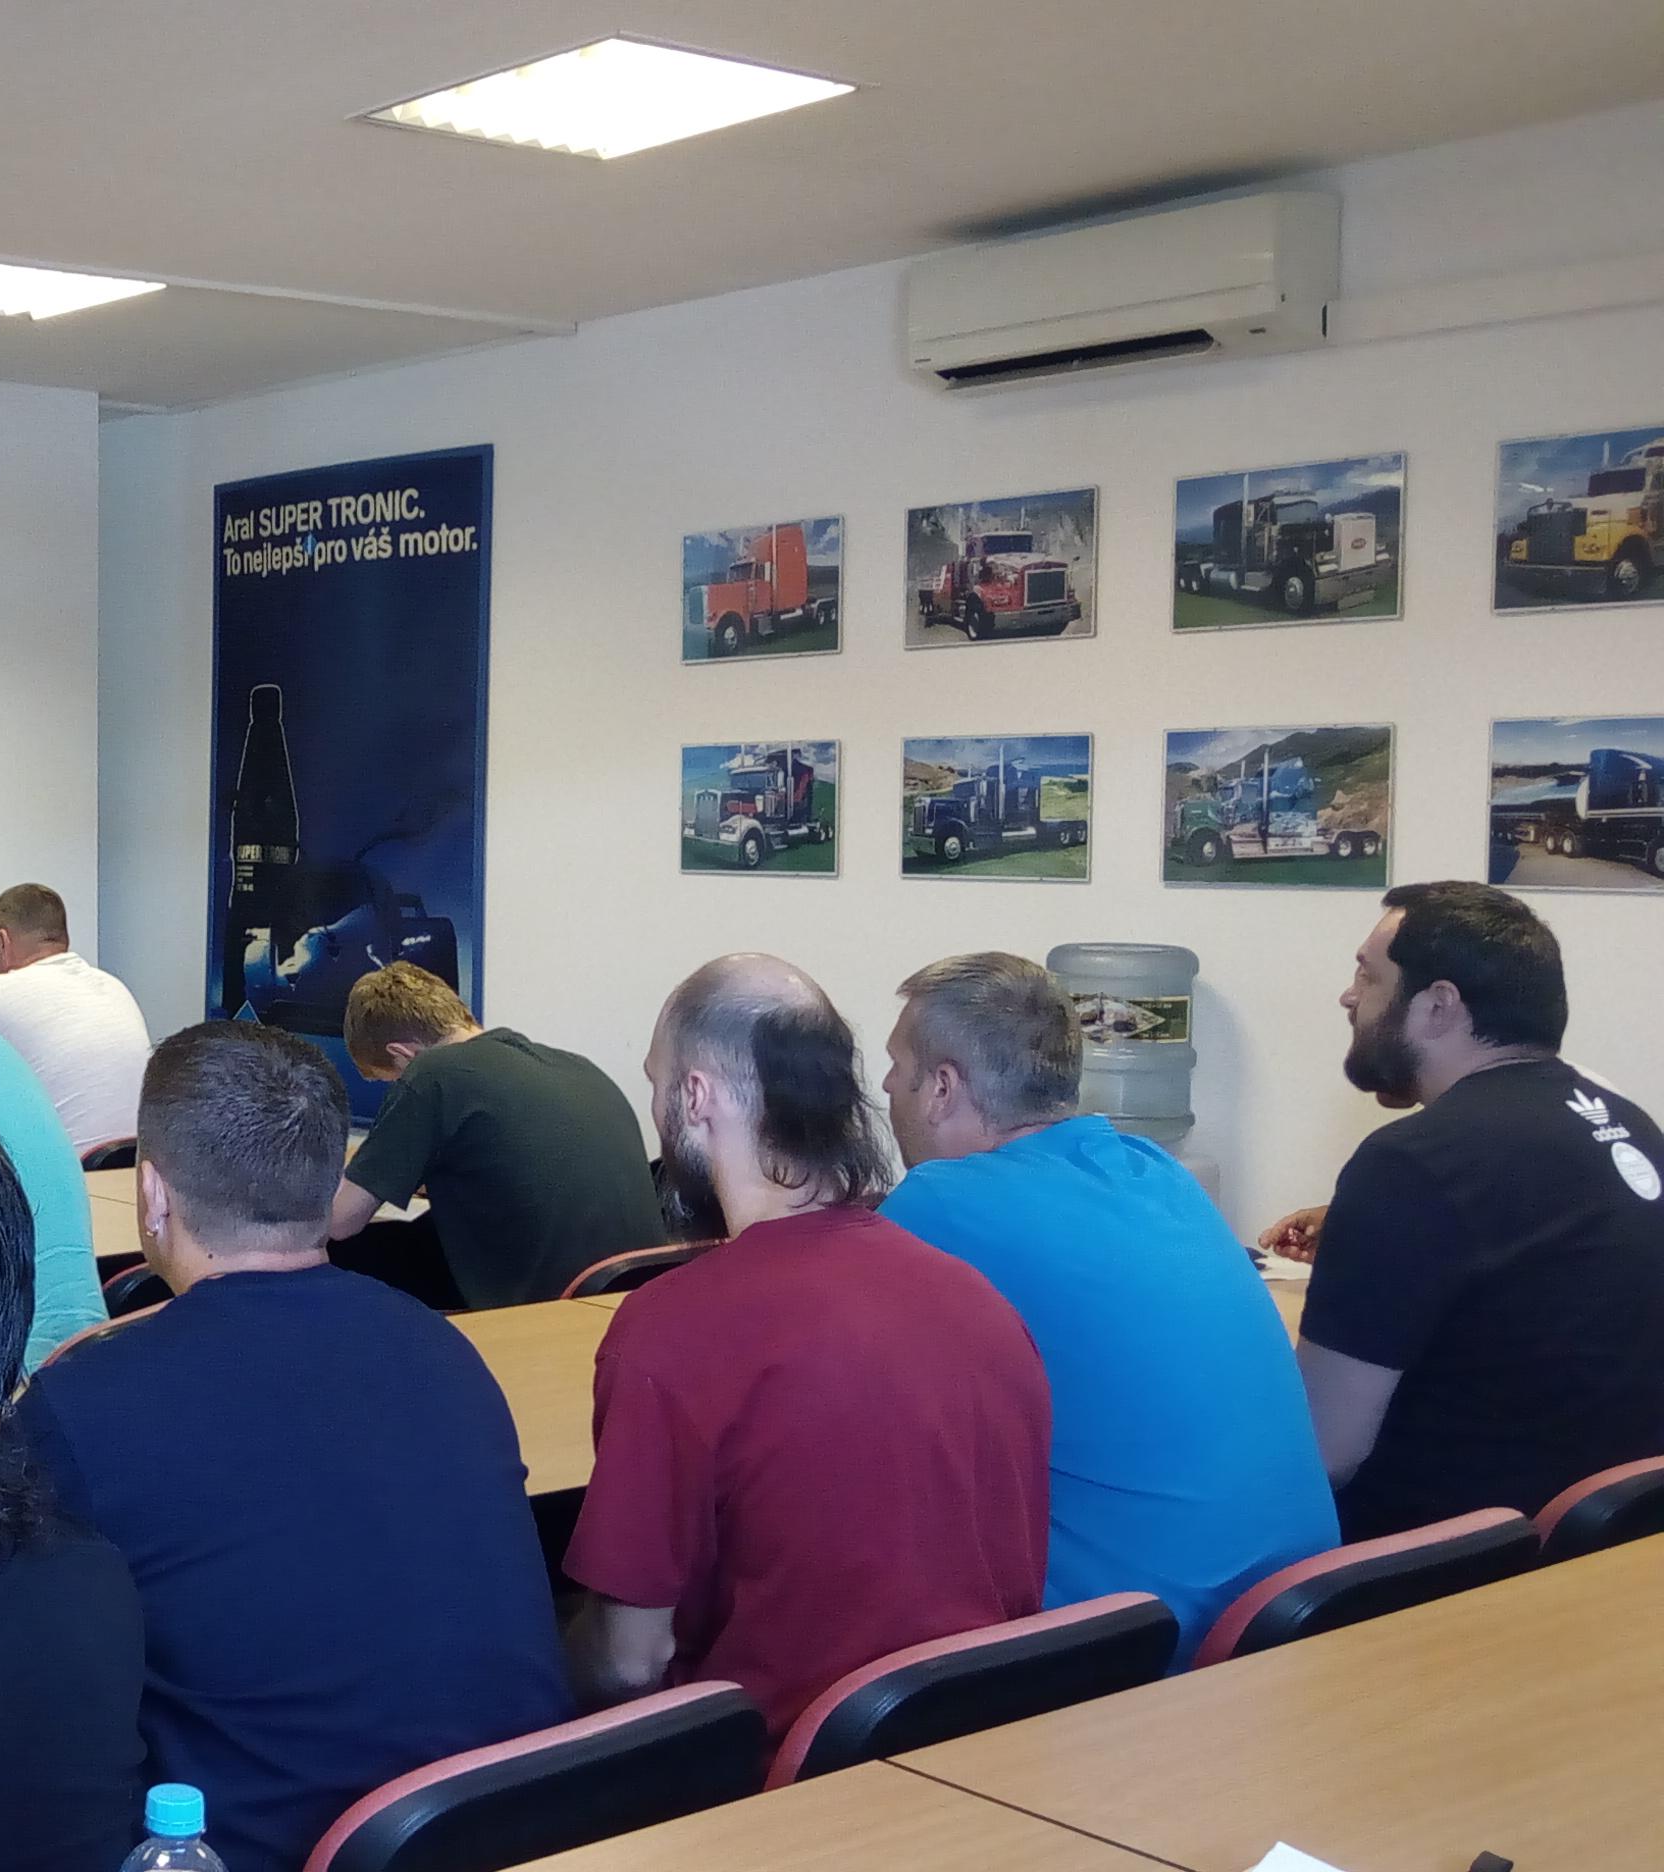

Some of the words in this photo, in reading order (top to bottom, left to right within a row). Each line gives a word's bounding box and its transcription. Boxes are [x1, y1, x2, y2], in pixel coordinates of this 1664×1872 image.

[223, 510, 254, 543] Aral
[259, 501, 323, 538] SUPER
[327, 488, 425, 528] TRONIC.
[223, 547, 241, 576] To
[314, 537, 347, 572] pro
[351, 526, 393, 561] váš
[399, 522, 478, 558] motor.
[1592, 1121, 1631, 1142] adidas
